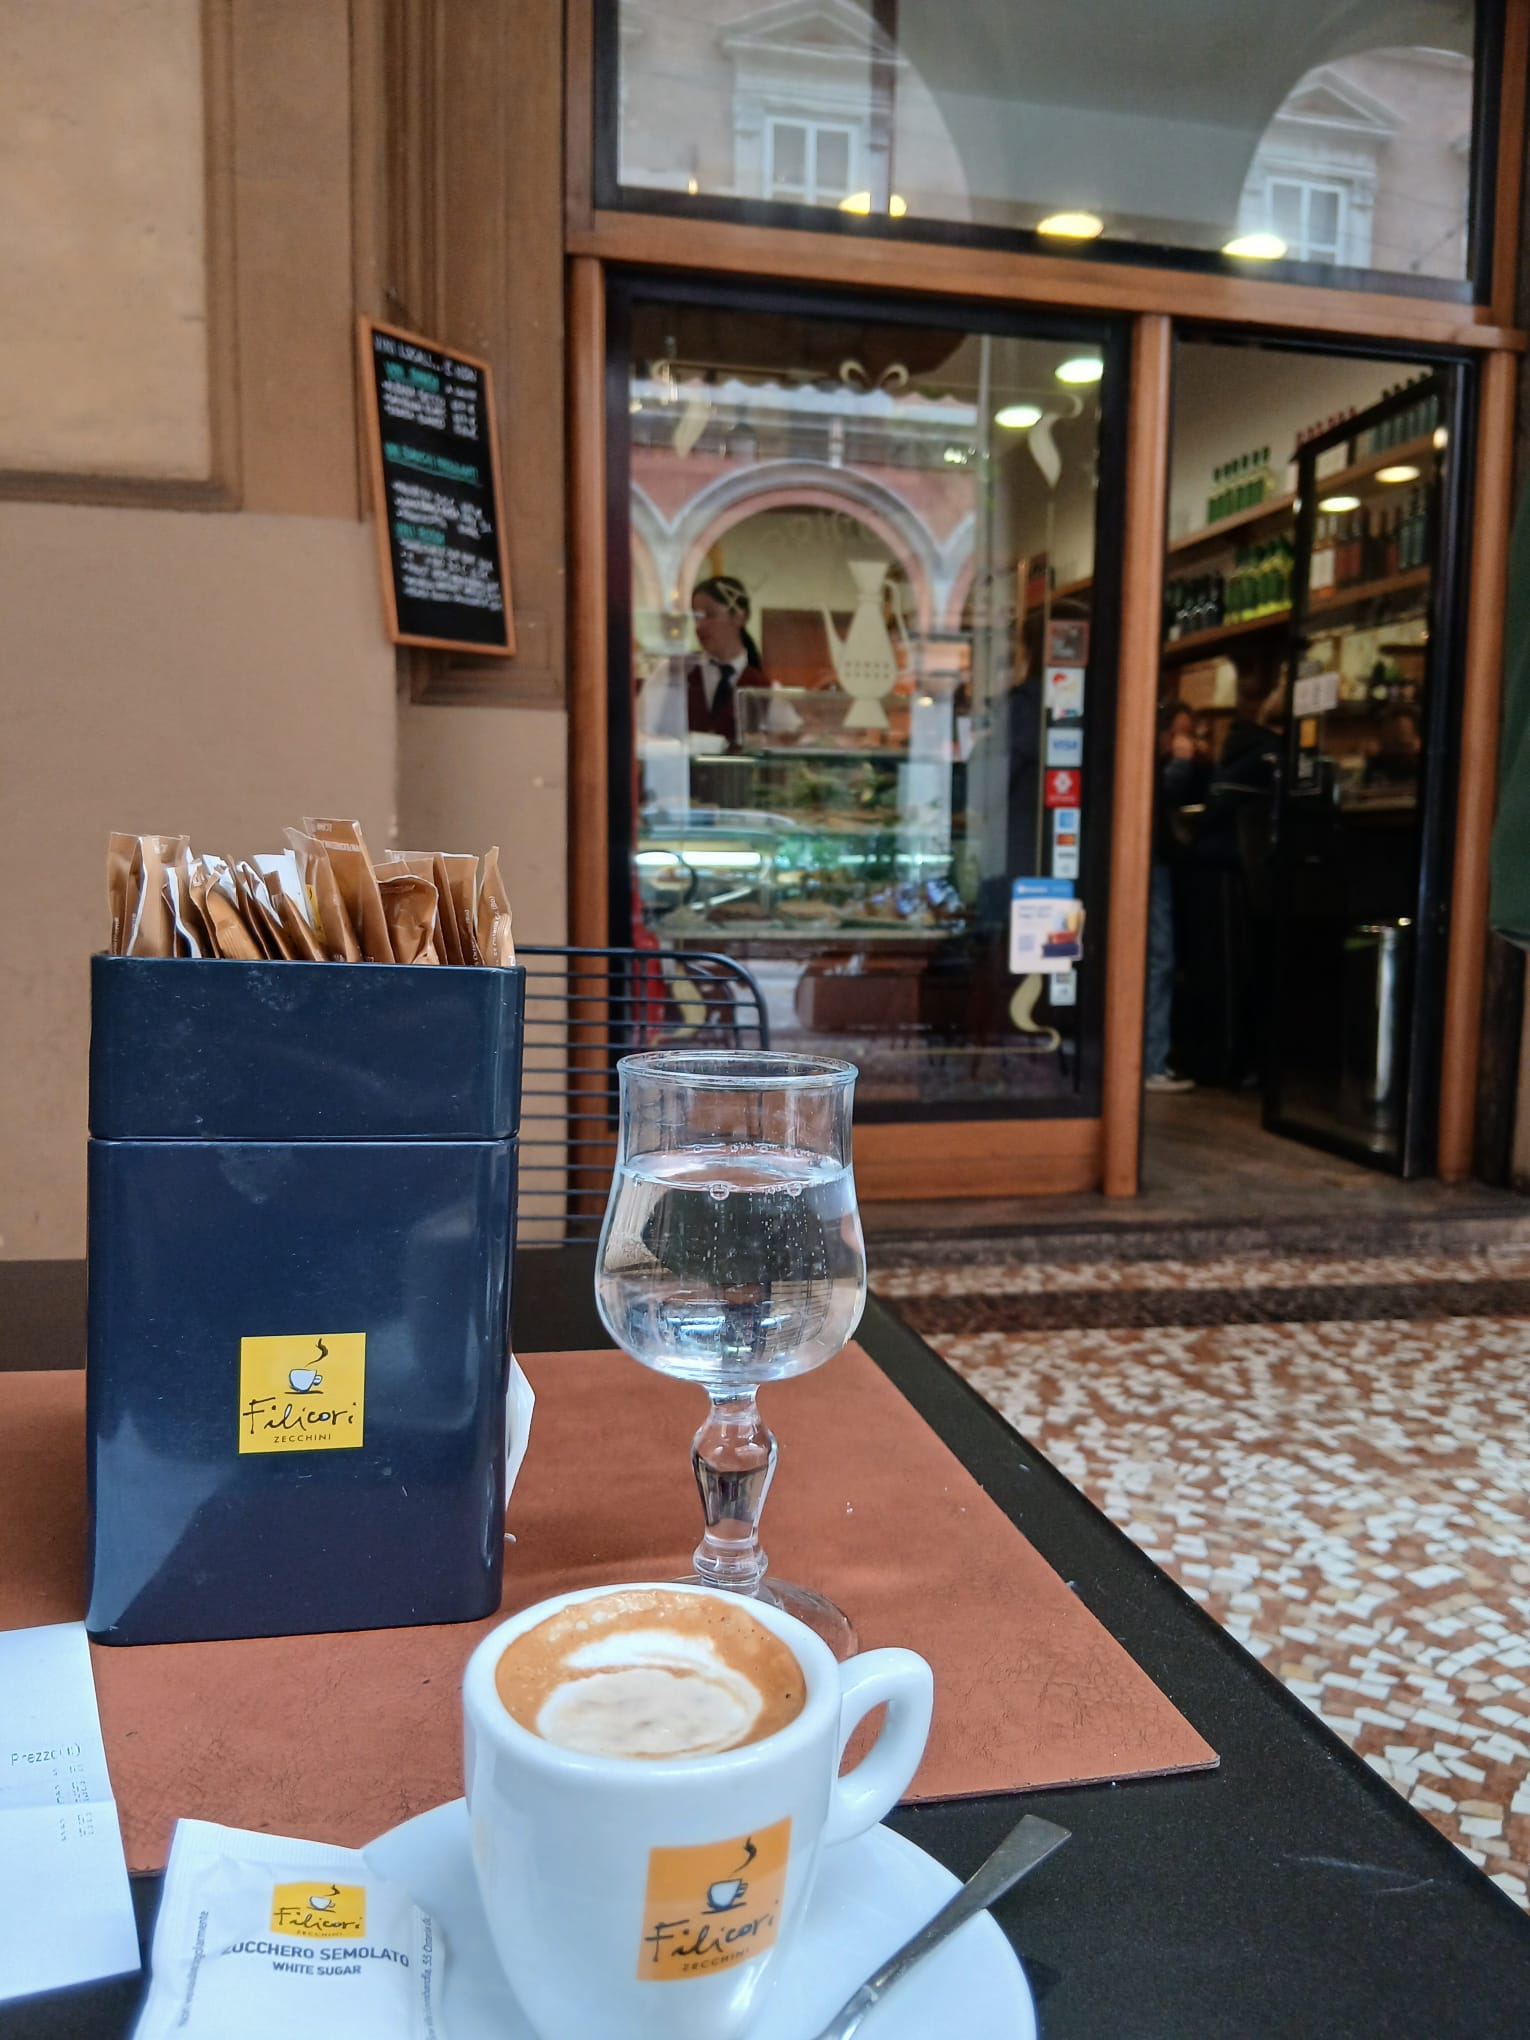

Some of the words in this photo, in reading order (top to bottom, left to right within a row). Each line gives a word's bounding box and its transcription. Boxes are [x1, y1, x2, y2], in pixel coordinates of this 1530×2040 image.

[242, 1397, 357, 1435] Filicori
[273, 1433, 332, 1444] ZECCHINI
[273, 1907, 364, 1931] Filicori
[644, 1897, 780, 1963] Filicori
[319, 1946, 410, 1968] SEMOLATO
[272, 1961, 314, 1976] WHITE
[317, 1964, 362, 1977] SUGAR
